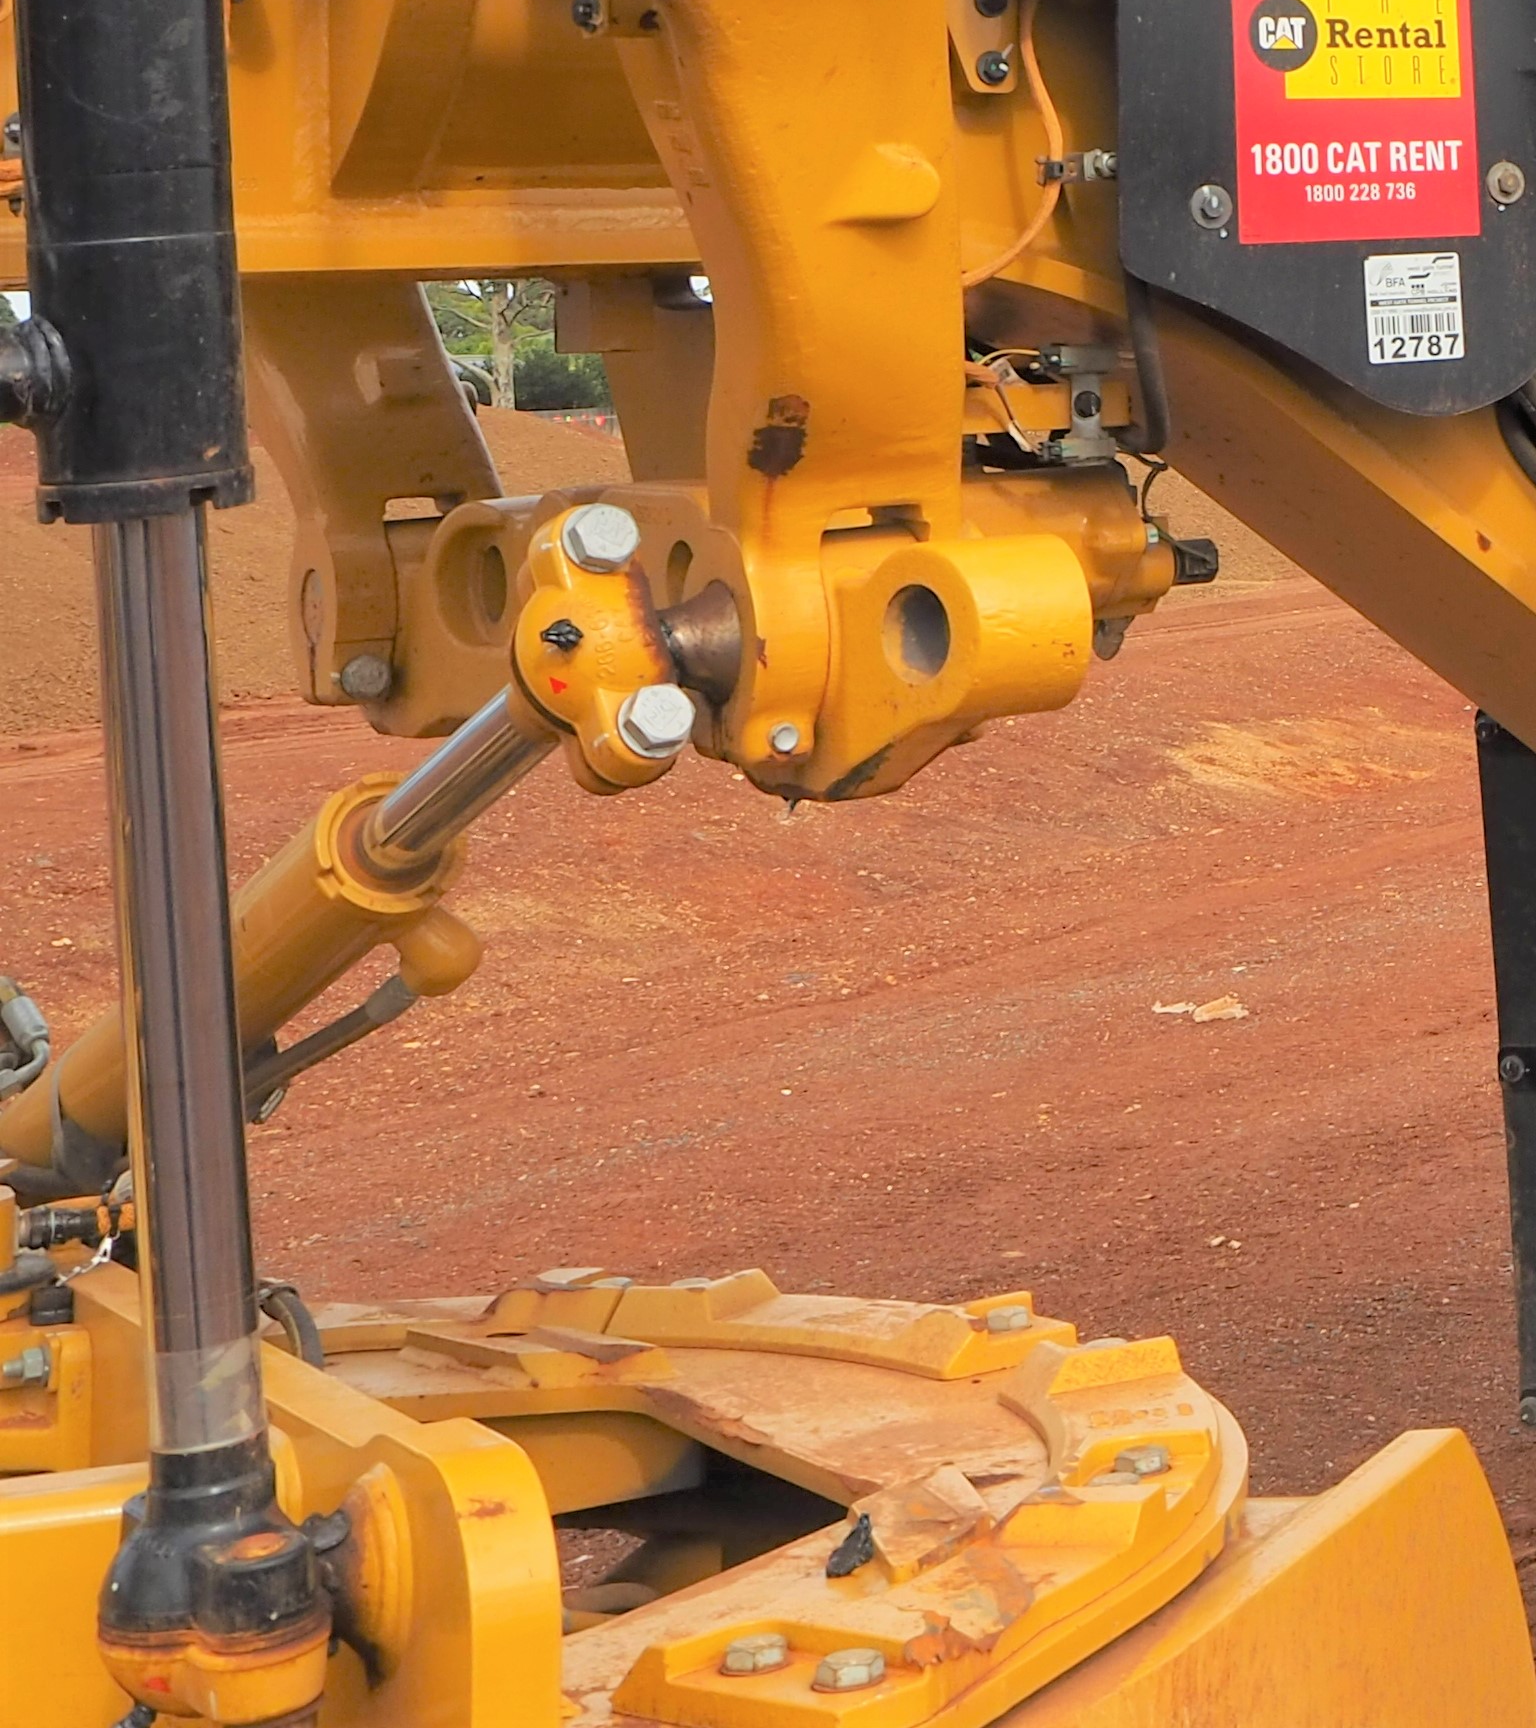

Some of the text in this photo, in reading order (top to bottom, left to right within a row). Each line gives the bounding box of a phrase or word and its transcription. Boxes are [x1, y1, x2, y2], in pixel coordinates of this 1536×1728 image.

[1258, 16, 1306, 50] CAT
[1326, 19, 1446, 49] Rental
[1251, 140, 1463, 175] 1800 CAT RENT
[1305, 182, 1416, 202] 1800 228 736
[1386, 277, 1405, 288] BFA
[1374, 333, 1459, 359] 12787
